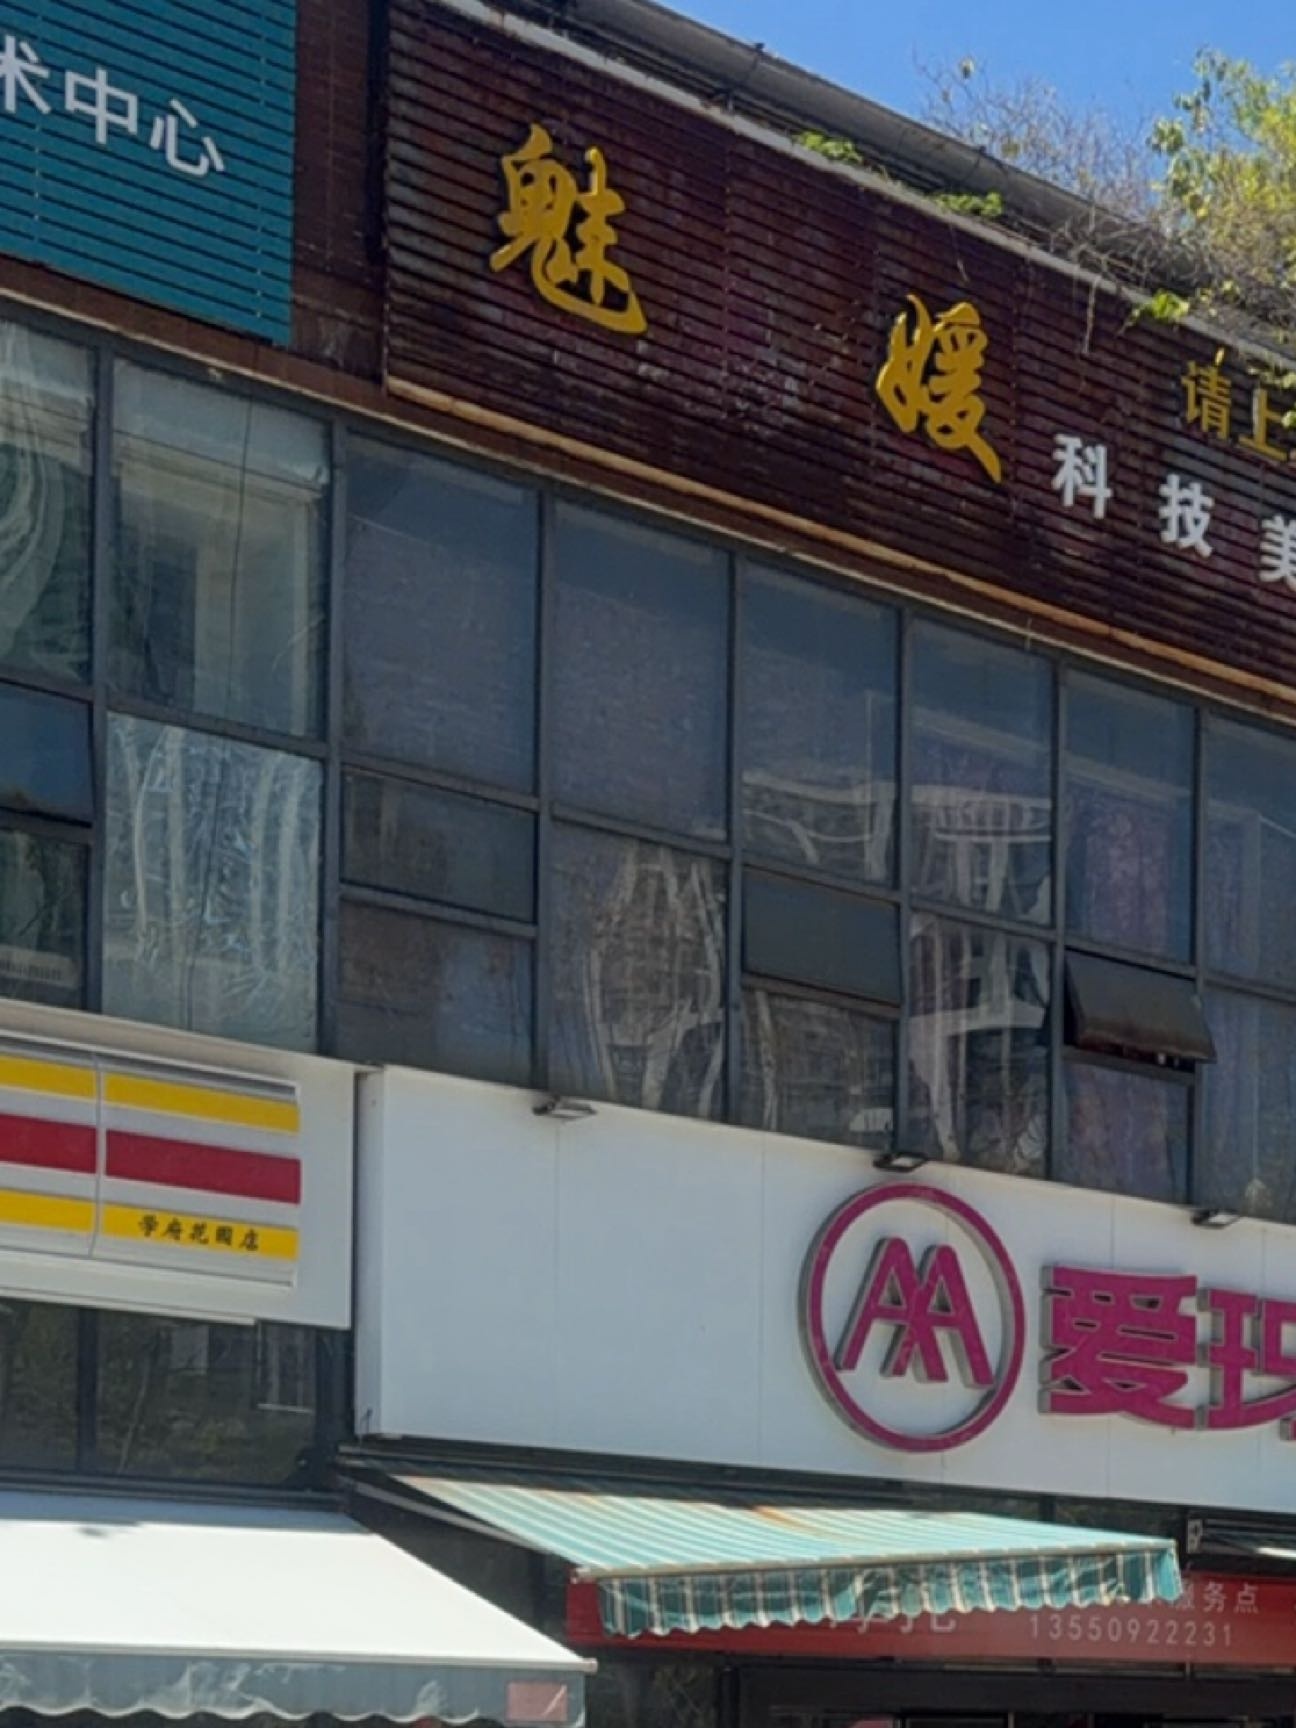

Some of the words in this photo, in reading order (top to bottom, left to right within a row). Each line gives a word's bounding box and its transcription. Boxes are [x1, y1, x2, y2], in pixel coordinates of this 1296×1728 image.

[0, 35, 225, 176] 术中心
[1155, 1581, 1260, 1615] 服务点
[1027, 1612, 1234, 1649] 13550922231
